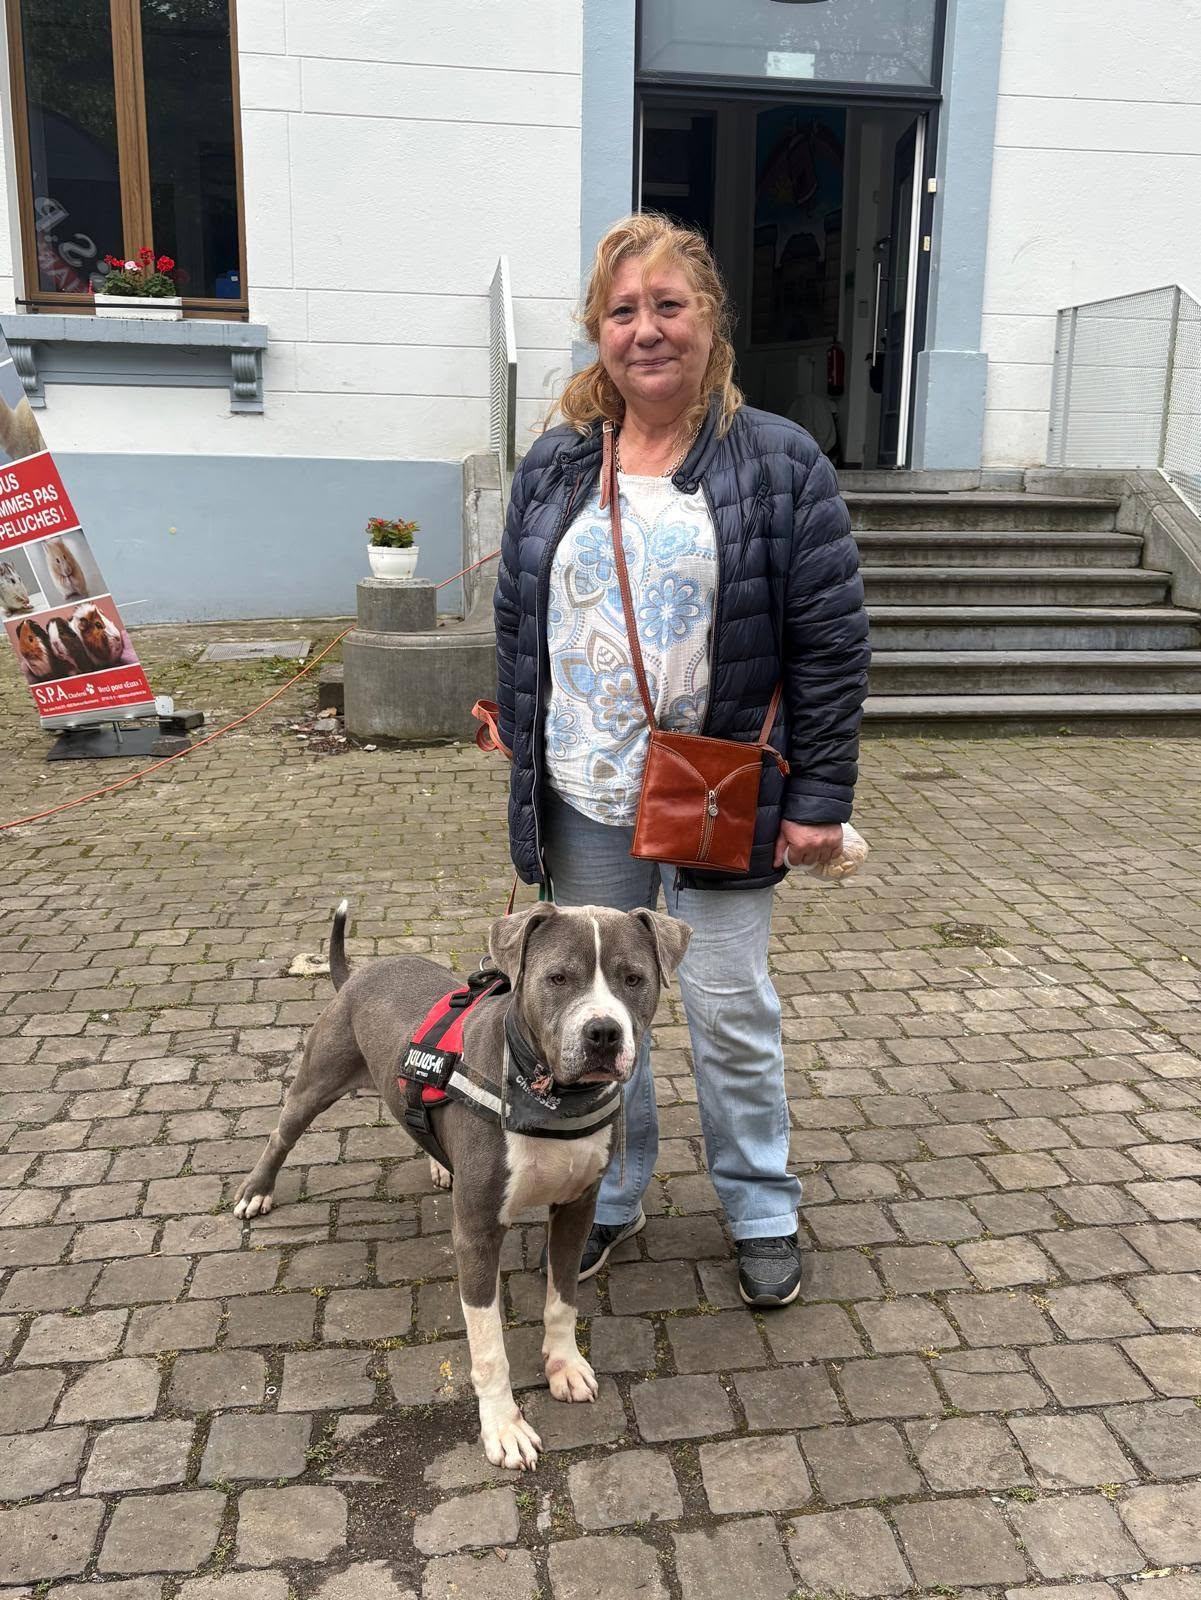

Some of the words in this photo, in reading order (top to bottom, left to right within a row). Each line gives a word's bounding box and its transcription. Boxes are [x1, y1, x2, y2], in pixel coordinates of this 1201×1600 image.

[32, 484, 58, 506] PAS
[0, 507, 61, 541] PELUCHES
[59, 505, 67, 521] !
[35, 685, 69, 704] S.P.A
